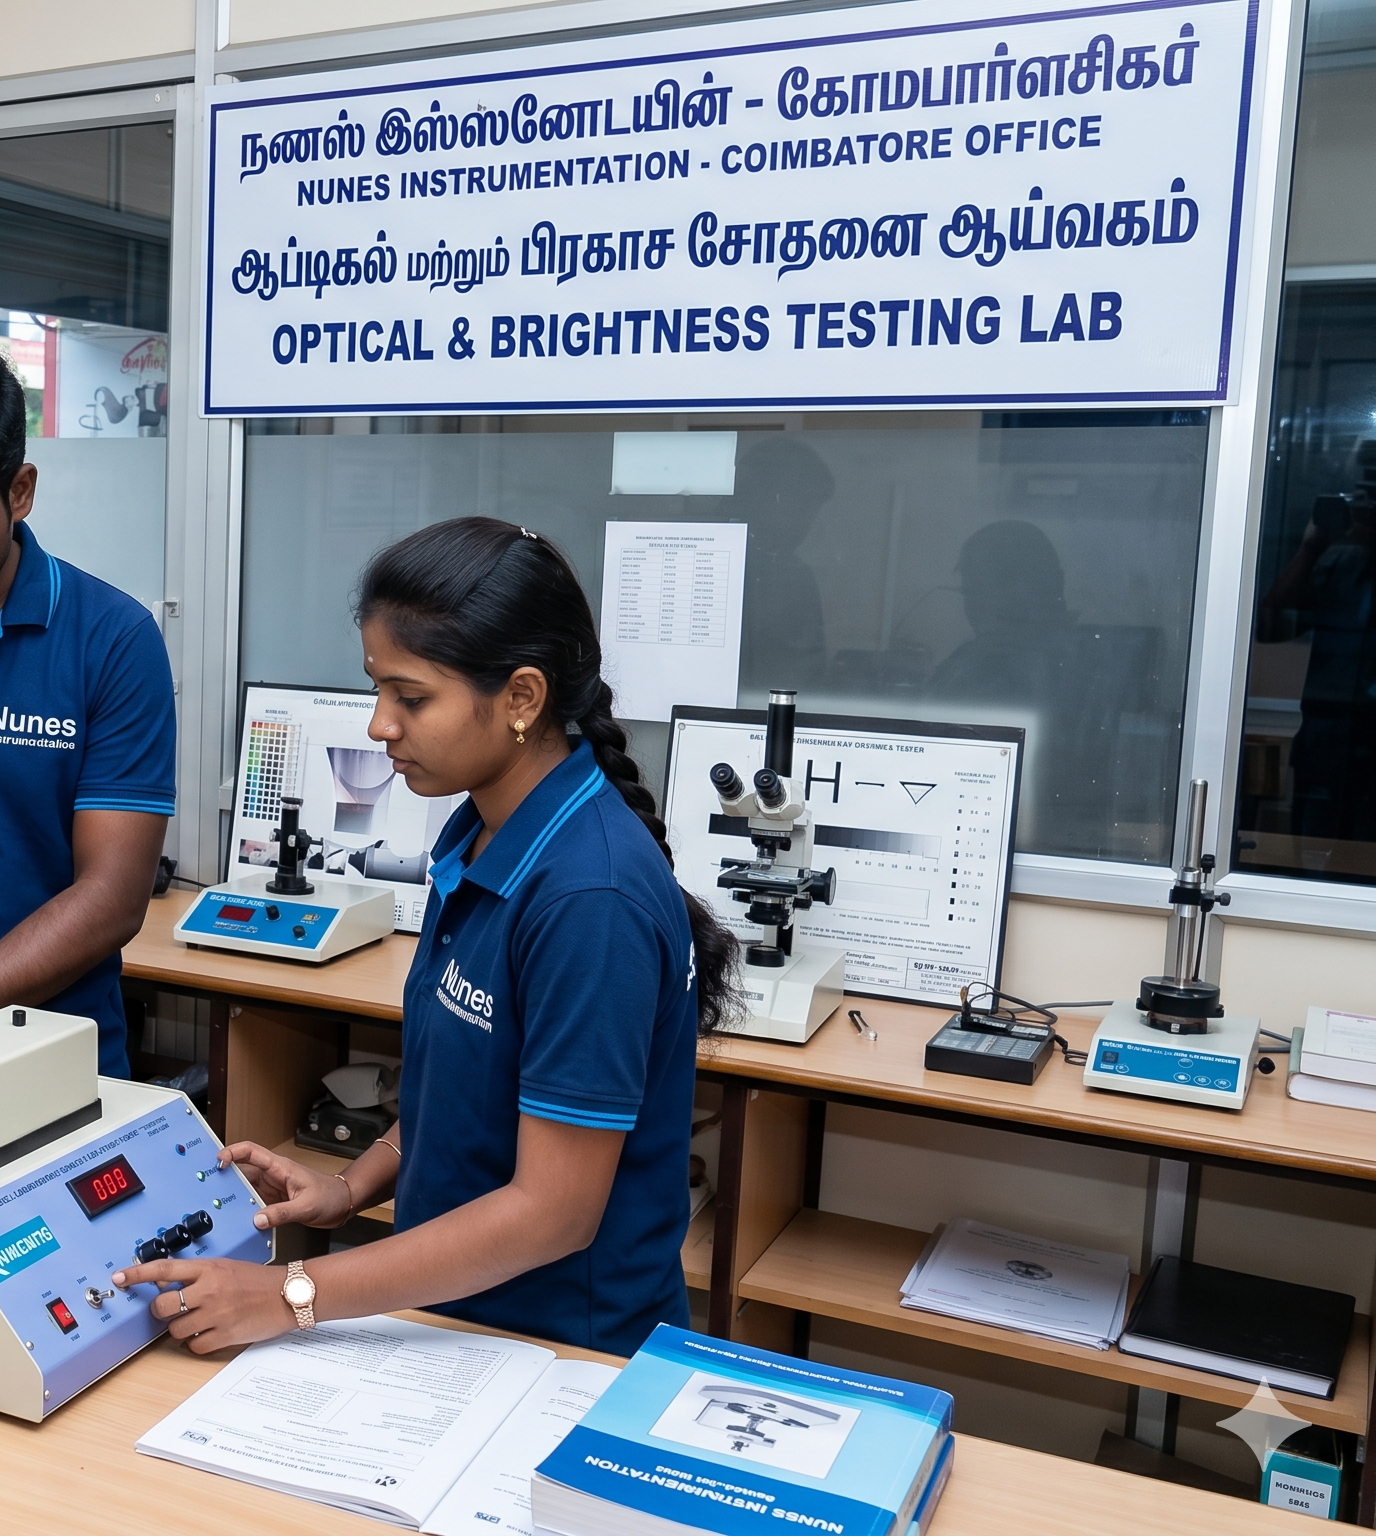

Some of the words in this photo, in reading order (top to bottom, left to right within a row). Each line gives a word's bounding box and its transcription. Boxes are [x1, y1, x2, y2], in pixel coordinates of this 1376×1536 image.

[297, 174, 390, 206] NUNES
[400, 149, 690, 198] INSTRUMENTATION
[721, 127, 953, 175] COIMBATORE
[965, 114, 1102, 157] OFFICE
[232, 229, 397, 300] ஆப்டிகல்
[407, 235, 510, 294] மற்றும்
[521, 220, 675, 286] பிரகாச
[938, 177, 1199, 267] ஆய்வகம்
[272, 318, 434, 365] OPTICAL
[447, 316, 476, 360] &
[490, 305, 770, 358] BRIGHTNESS
[787, 296, 1001, 350] TESTING
[1020, 291, 1123, 344] LAB
[441, 958, 493, 1017] Nunes
